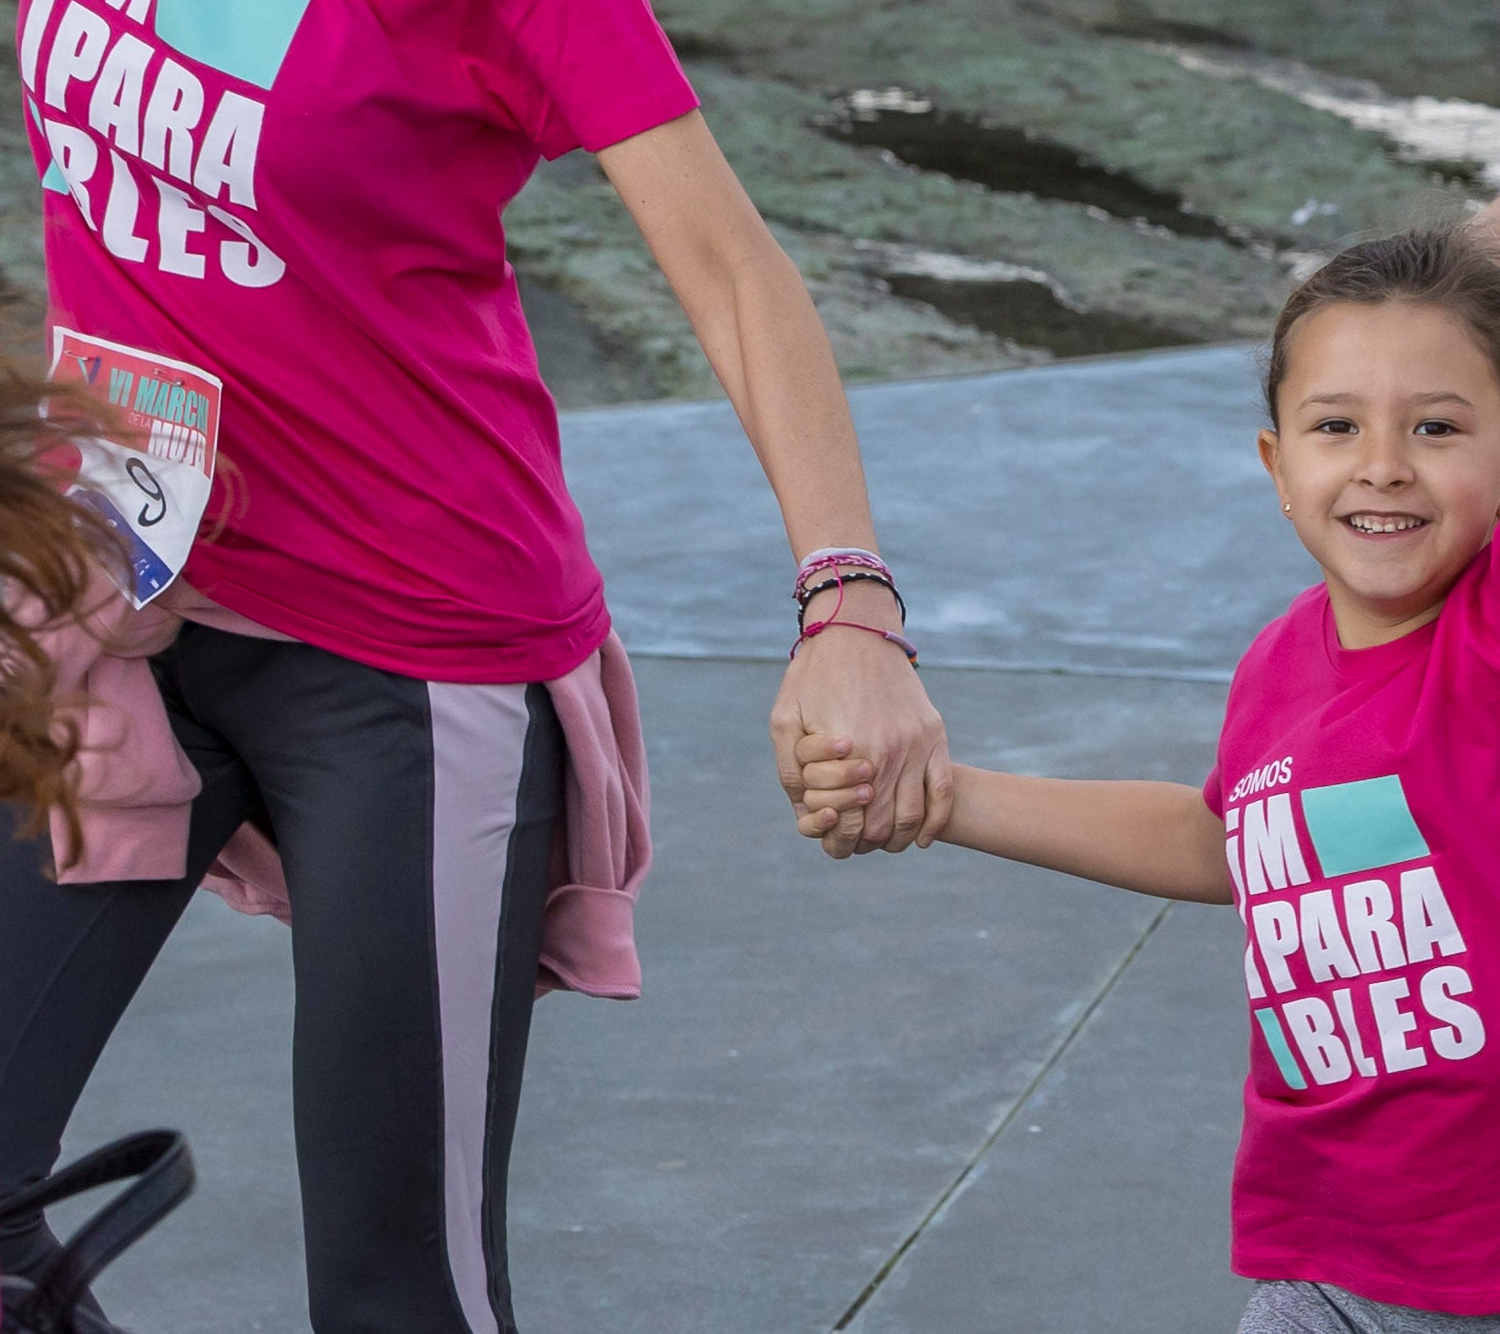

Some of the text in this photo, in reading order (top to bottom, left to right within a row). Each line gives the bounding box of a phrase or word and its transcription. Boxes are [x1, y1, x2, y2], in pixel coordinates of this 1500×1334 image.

[45, 0, 265, 211] PARA
[108, 367, 134, 407] VI
[1228, 756, 1293, 803] SOMOS
[1252, 866, 1467, 994] PARA
[1282, 965, 1486, 1086] BLES
